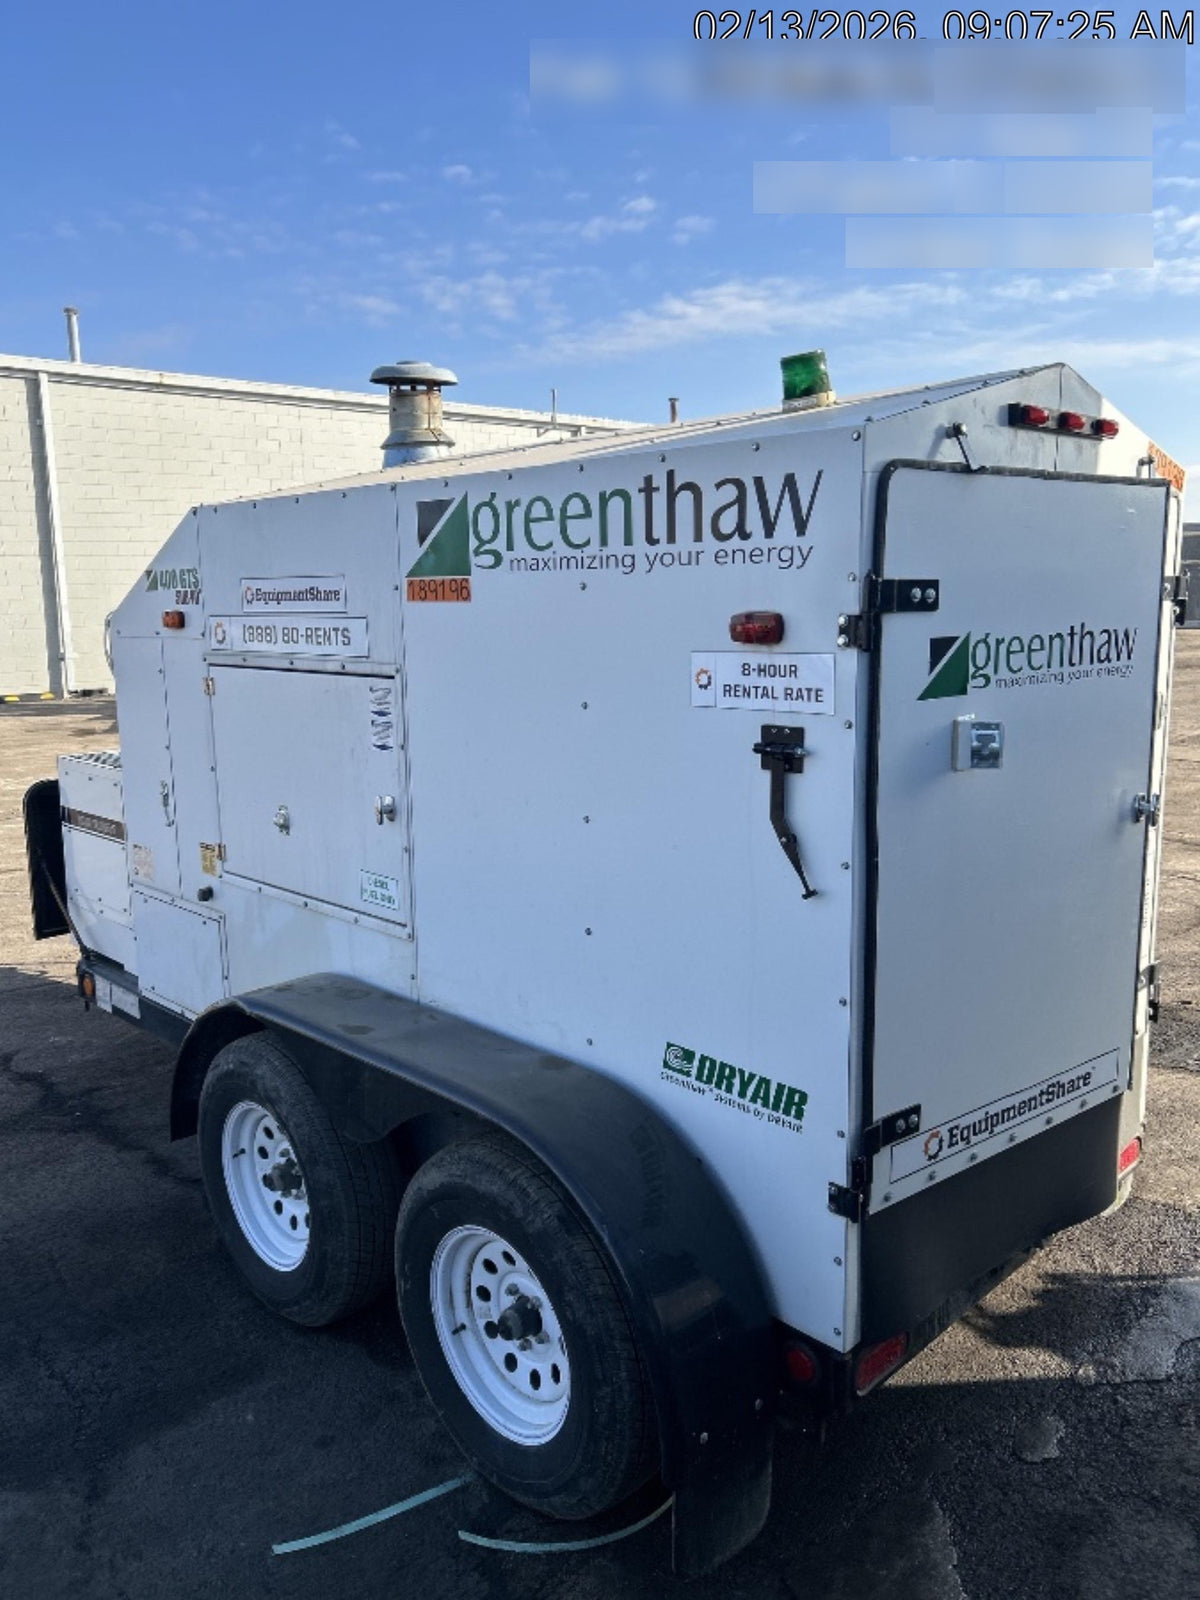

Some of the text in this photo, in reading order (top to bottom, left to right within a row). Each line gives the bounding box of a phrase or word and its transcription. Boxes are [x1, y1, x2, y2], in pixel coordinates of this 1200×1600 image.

[472, 469, 824, 570] greenthaw
[509, 544, 815, 577] maximizing your energy
[255, 586, 341, 605] EquipmentShare
[407, 578, 470, 602] 189196
[243, 623, 278, 645] (888)
[970, 621, 1138, 689] greenthaw
[741, 662, 798, 678] 8-HOUR
[995, 664, 1134, 689] maximizing your energy
[723, 683, 824, 703] RENTAL RATE
[695, 1053, 808, 1122] DRYAIR
[947, 1070, 1093, 1150] EquipmentShare
